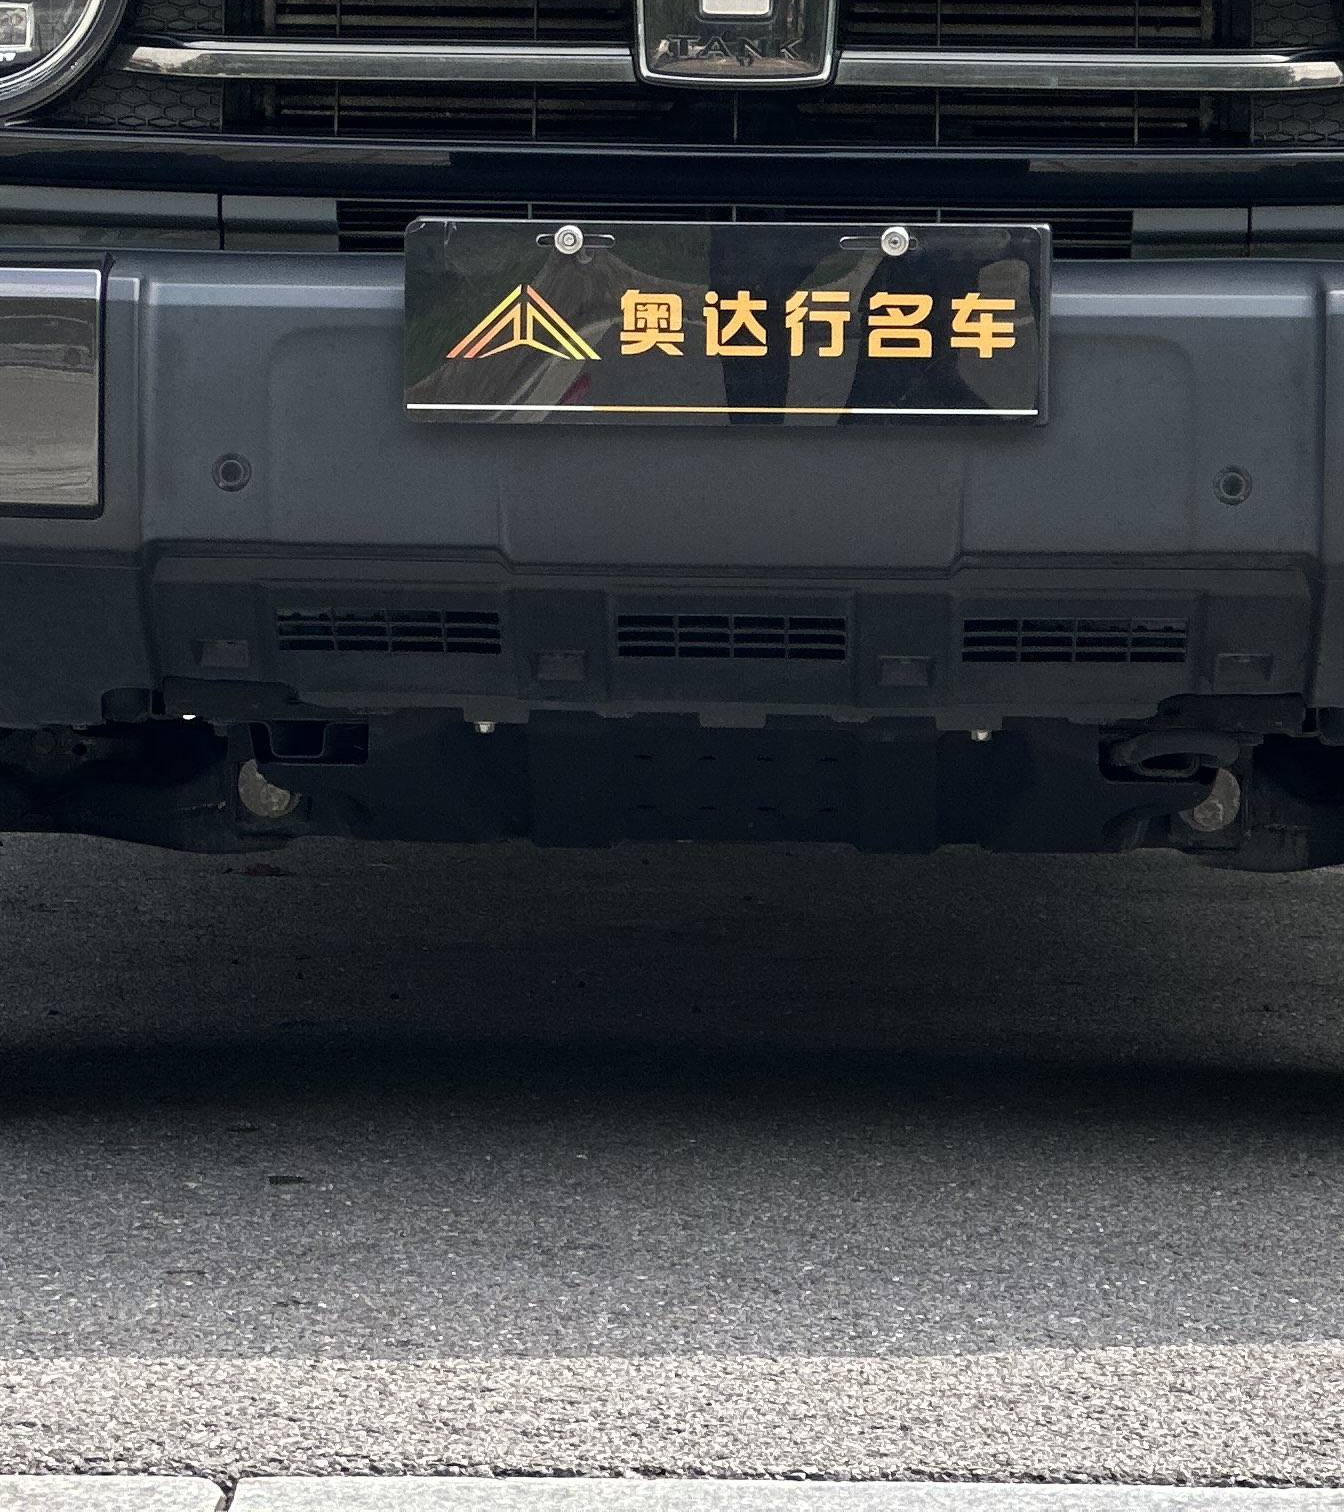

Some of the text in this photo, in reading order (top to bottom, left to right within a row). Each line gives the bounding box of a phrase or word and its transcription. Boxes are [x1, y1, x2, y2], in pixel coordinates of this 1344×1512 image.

[666, 34, 802, 60] TANK
[619, 289, 1017, 359] 奥达行名车
